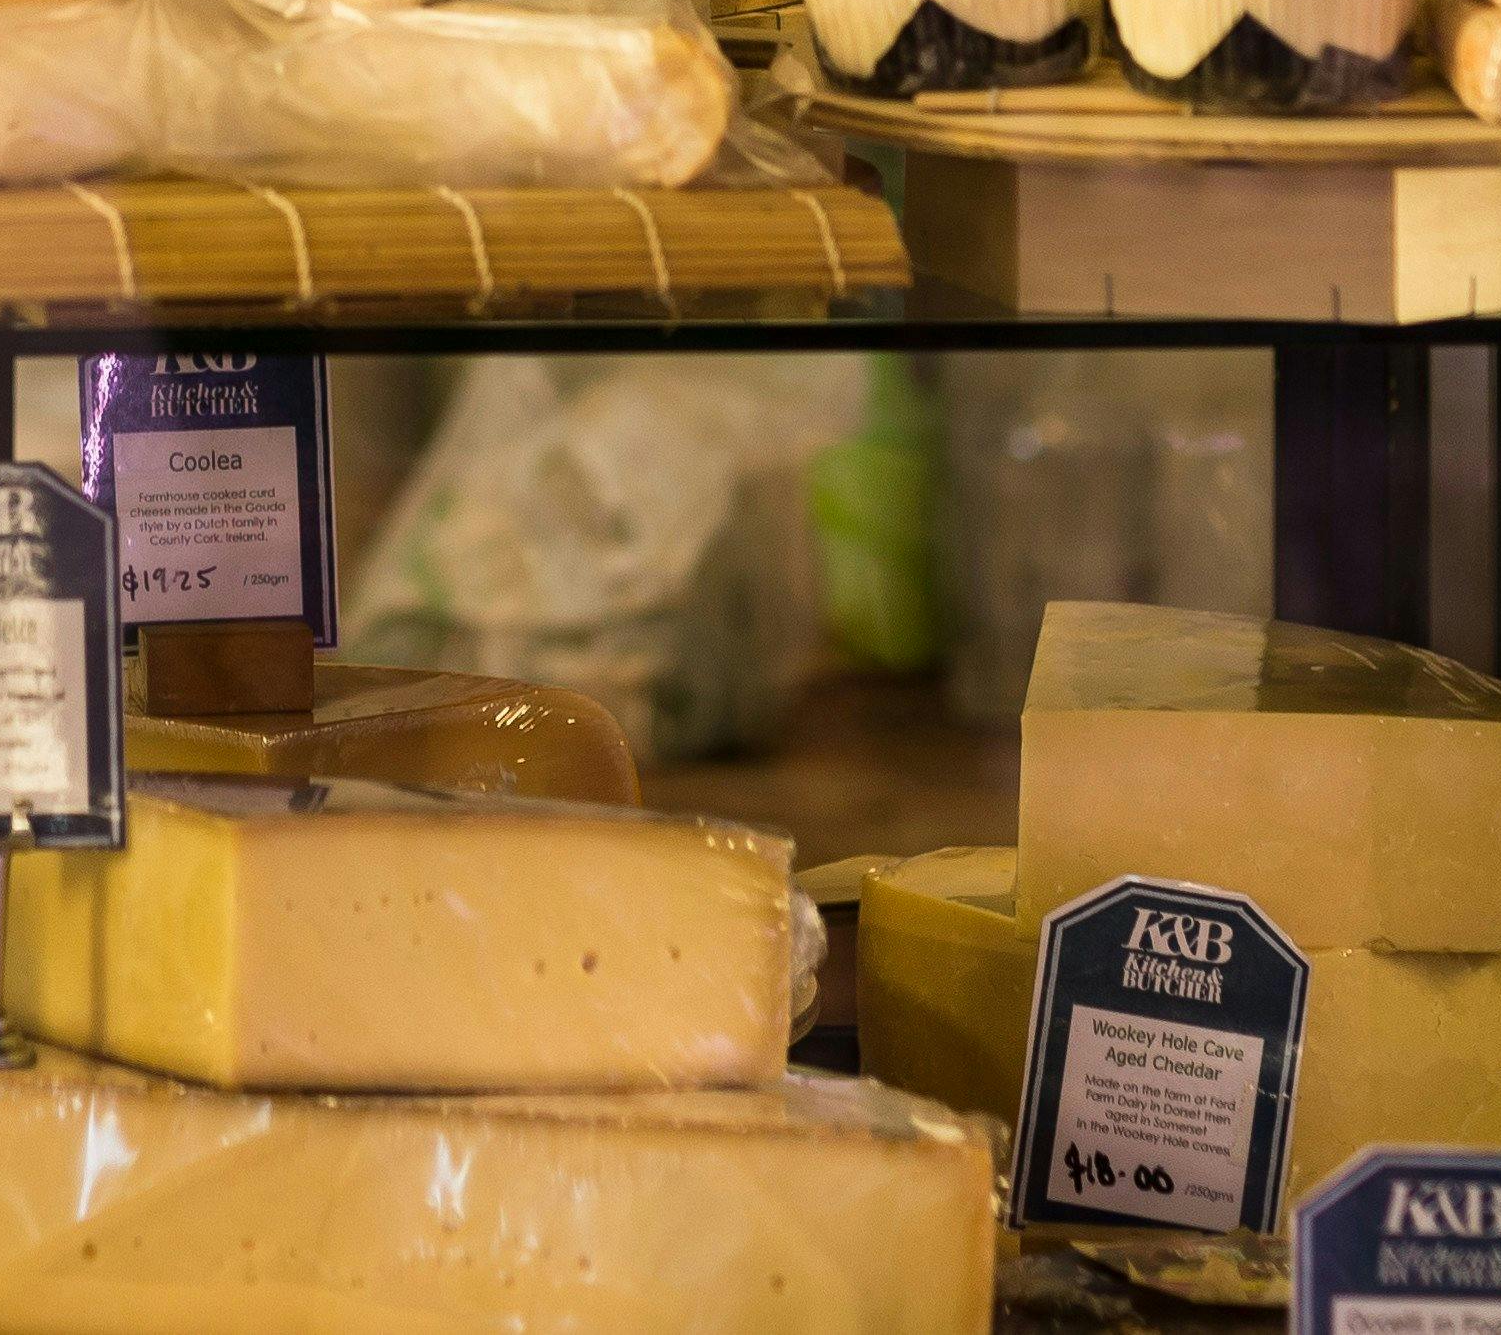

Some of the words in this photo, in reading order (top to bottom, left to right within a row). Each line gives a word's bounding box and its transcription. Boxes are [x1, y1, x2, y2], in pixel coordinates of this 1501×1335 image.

[169, 450, 243, 472] Coolea
[1121, 906, 1234, 965] K&B
[1091, 1018, 1156, 1048] Wookey
[1161, 1032, 1198, 1054] Hole
[1203, 1039, 1245, 1062] Cave
[1104, 1046, 1147, 1071] Aged
[1152, 1055, 1224, 1082] Cheddar
